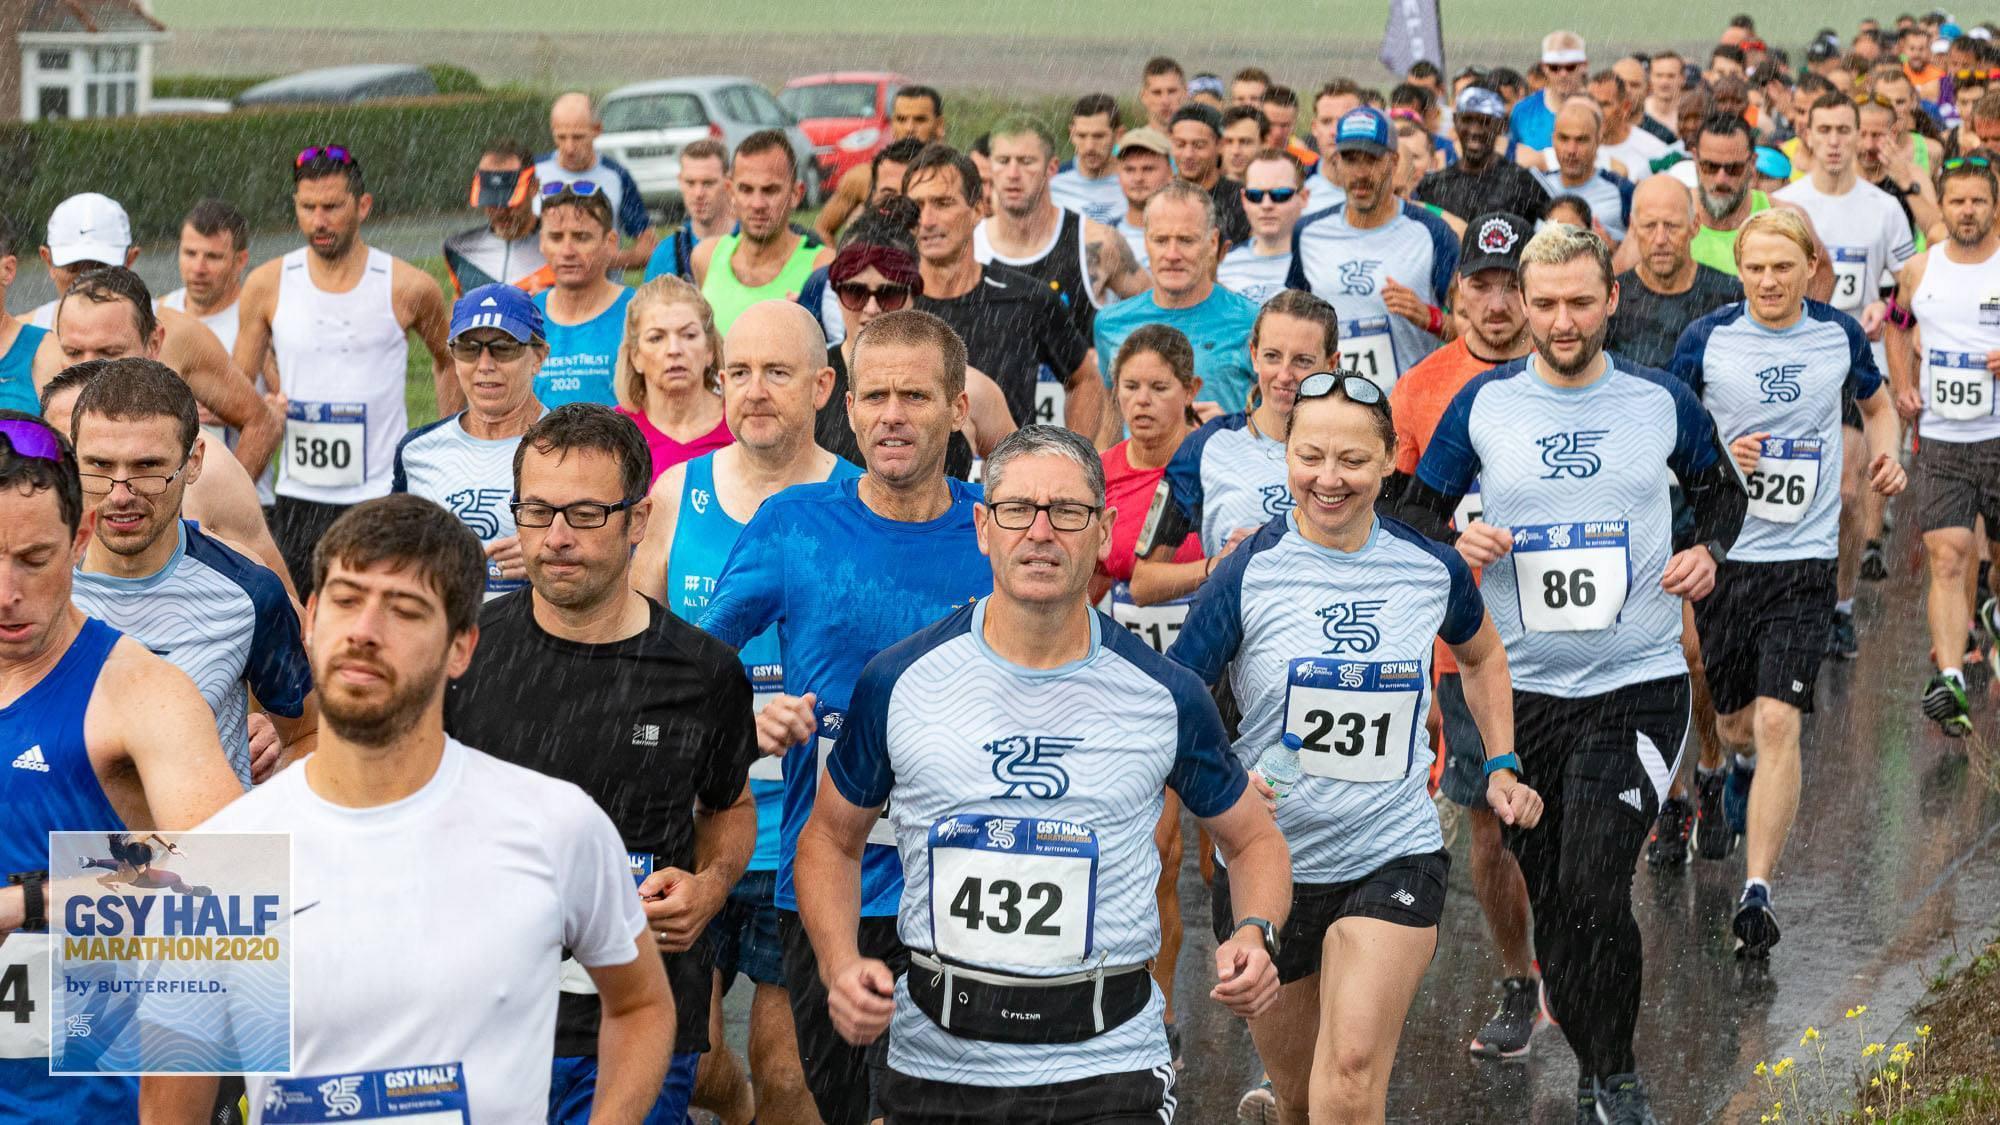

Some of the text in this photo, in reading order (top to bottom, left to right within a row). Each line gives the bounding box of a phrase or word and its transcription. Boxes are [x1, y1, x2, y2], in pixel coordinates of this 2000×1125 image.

[551, 377, 580, 391] 2020
[1936, 379, 1982, 406] 595
[295, 437, 351, 469] 580
[1746, 470, 1805, 506] 526
[489, 566, 501, 576] GS
[1542, 568, 1596, 609] 86
[684, 596, 698, 607] ALL
[753, 666, 772, 677] GSY
[1381, 662, 1418, 674] GSY HALF
[1302, 709, 1391, 757] 231
[12, 759, 50, 772] adidas
[1037, 821, 1090, 837] GSY HALF
[949, 876, 1063, 936] 432
[0, 964, 35, 1024] 4
[385, 1066, 458, 1089] GSY HALF
